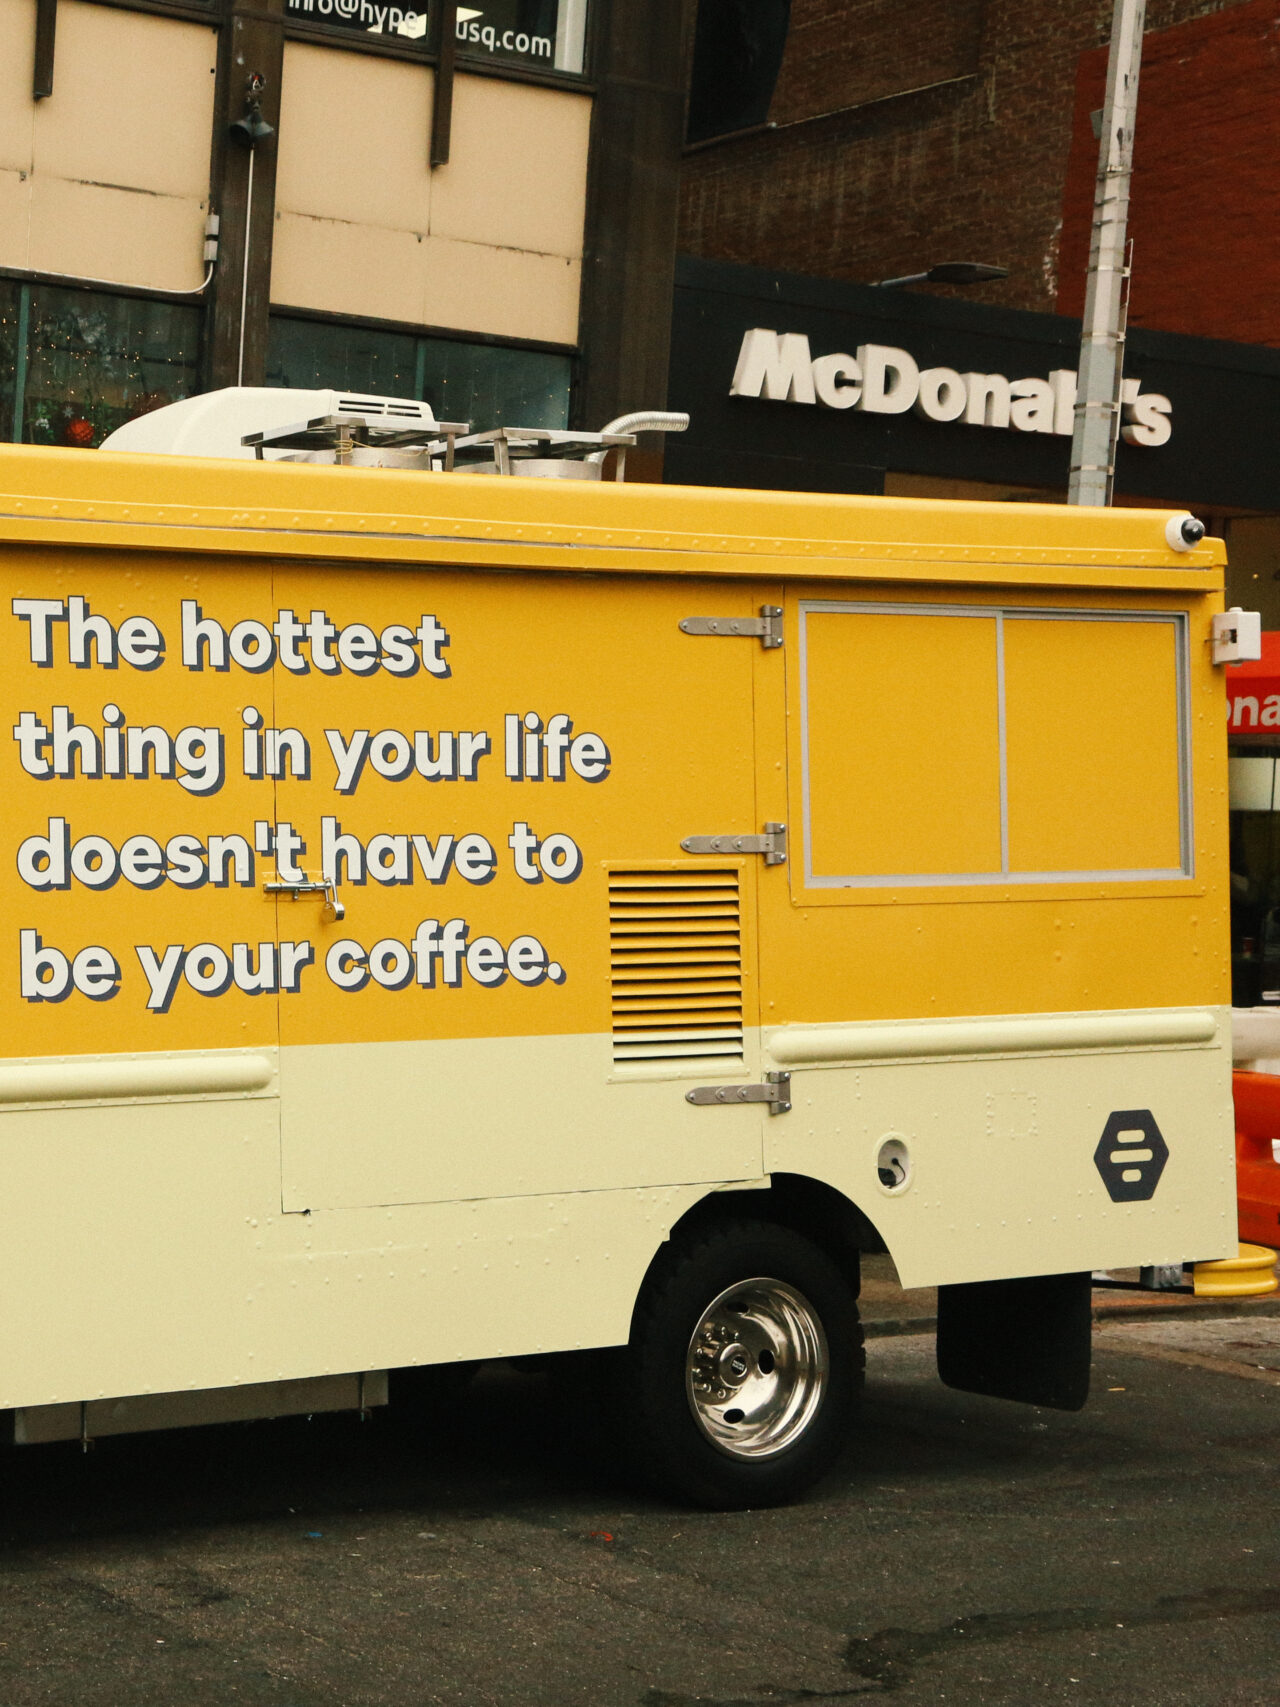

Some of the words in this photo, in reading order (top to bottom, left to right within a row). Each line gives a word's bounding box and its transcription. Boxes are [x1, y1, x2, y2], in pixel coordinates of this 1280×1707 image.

[729, 327, 1172, 447] McDonal's
[12, 596, 165, 670] The
[181, 599, 452, 677] hottest
[13, 703, 225, 796] thing
[242, 706, 311, 780] in
[324, 729, 490, 795] your
[504, 711, 611, 783] life
[16, 817, 308, 891] doesn't
[321, 816, 497, 887] have
[508, 822, 583, 885] to
[20, 928, 121, 1003] be
[135, 940, 314, 1014] your
[325, 919, 567, 990] coffee.
